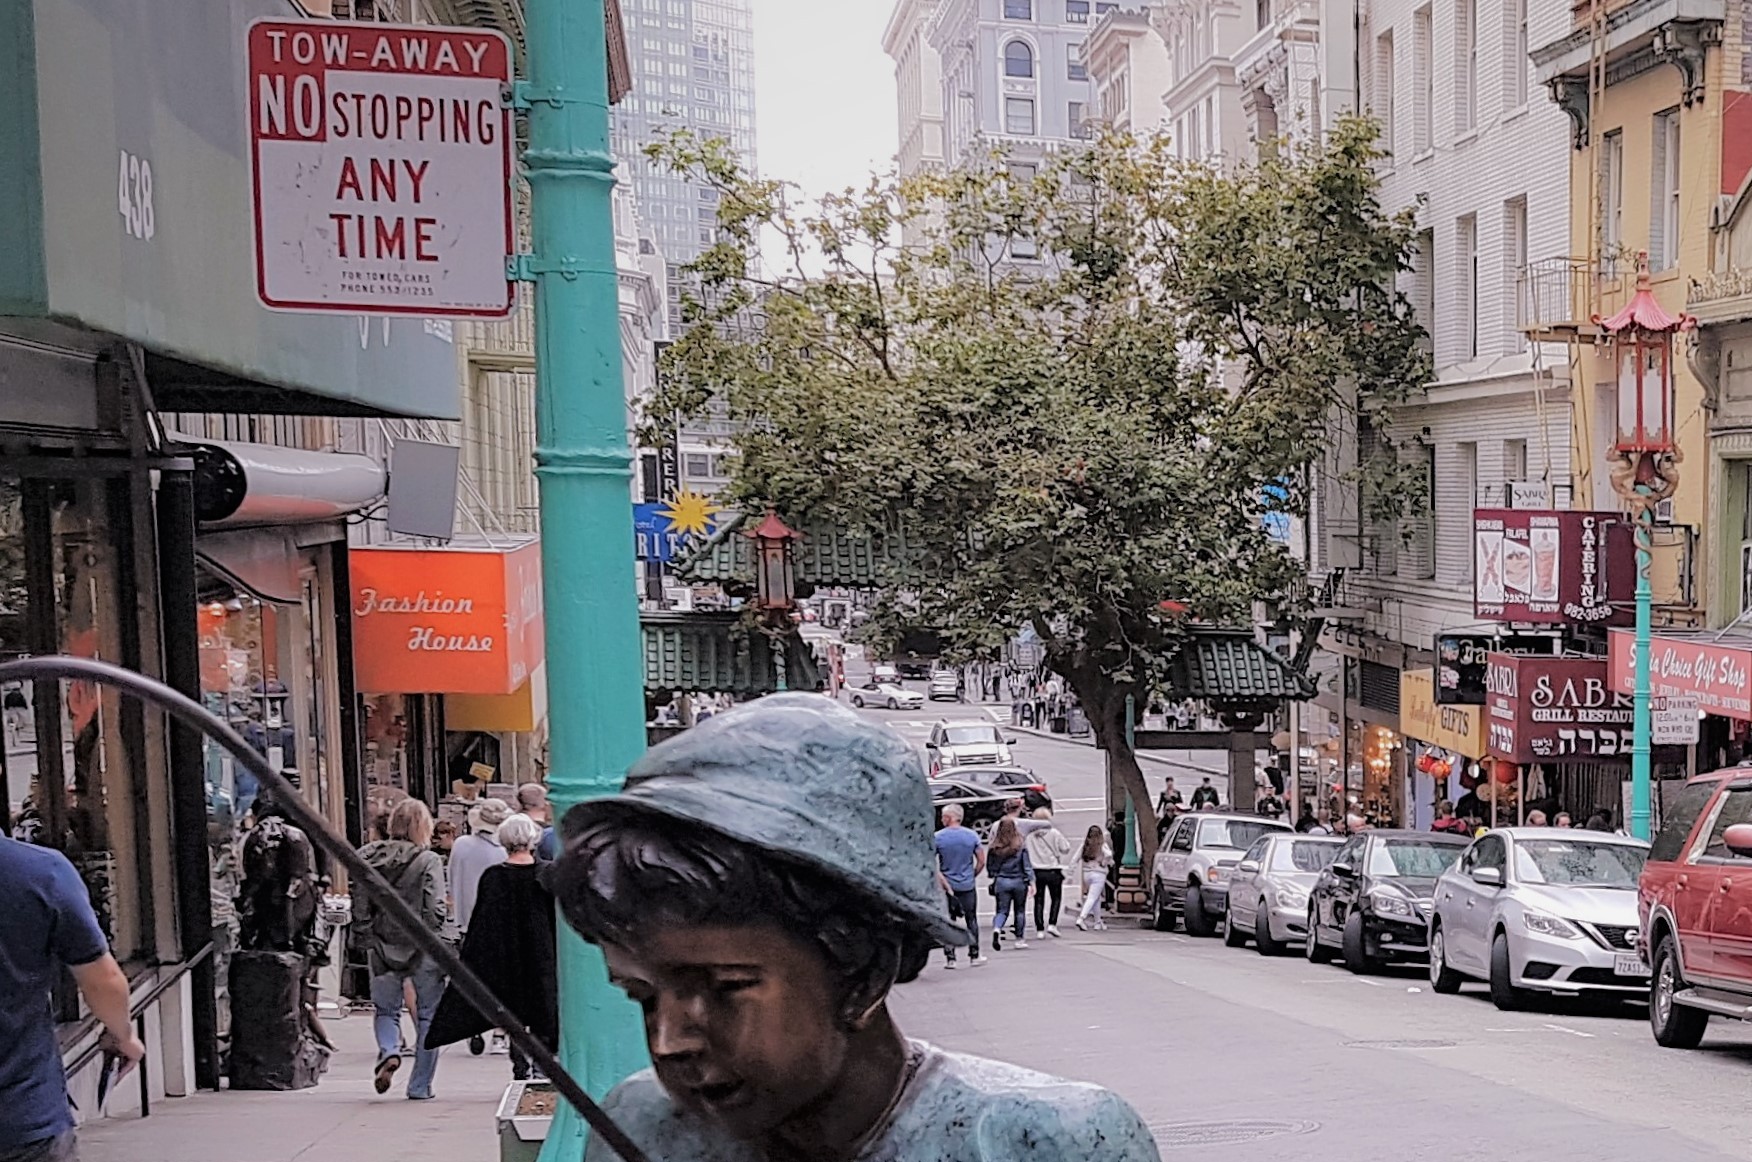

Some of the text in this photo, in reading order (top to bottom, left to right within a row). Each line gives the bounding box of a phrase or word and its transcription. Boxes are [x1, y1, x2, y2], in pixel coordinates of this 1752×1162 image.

[266, 31, 489, 74] TOW-AWAY
[258, 73, 495, 145] NO STOPPING
[118, 149, 155, 242] 438
[335, 156, 430, 204] ANY
[328, 213, 439, 262] TIME
[340, 283, 375, 294] PHONE
[342, 270, 361, 281] FOR
[404, 273, 430, 284] CARS
[1580, 516, 1597, 608] CATERING
[354, 588, 473, 617] Fashion
[1563, 602, 1613, 621] 982-3656
[408, 626, 493, 652] House
[1486, 662, 1519, 698] SABRA
[1661, 647, 1693, 678] Choice
[1694, 651, 1717, 690] Gift
[1719, 656, 1746, 694] Shop
[1531, 674, 1634, 708] SAB
[1653, 697, 1697, 711] NO PARKING
[1441, 706, 1470, 737] GIFTS
[1531, 708, 1634, 723] GRILL RESTAU
